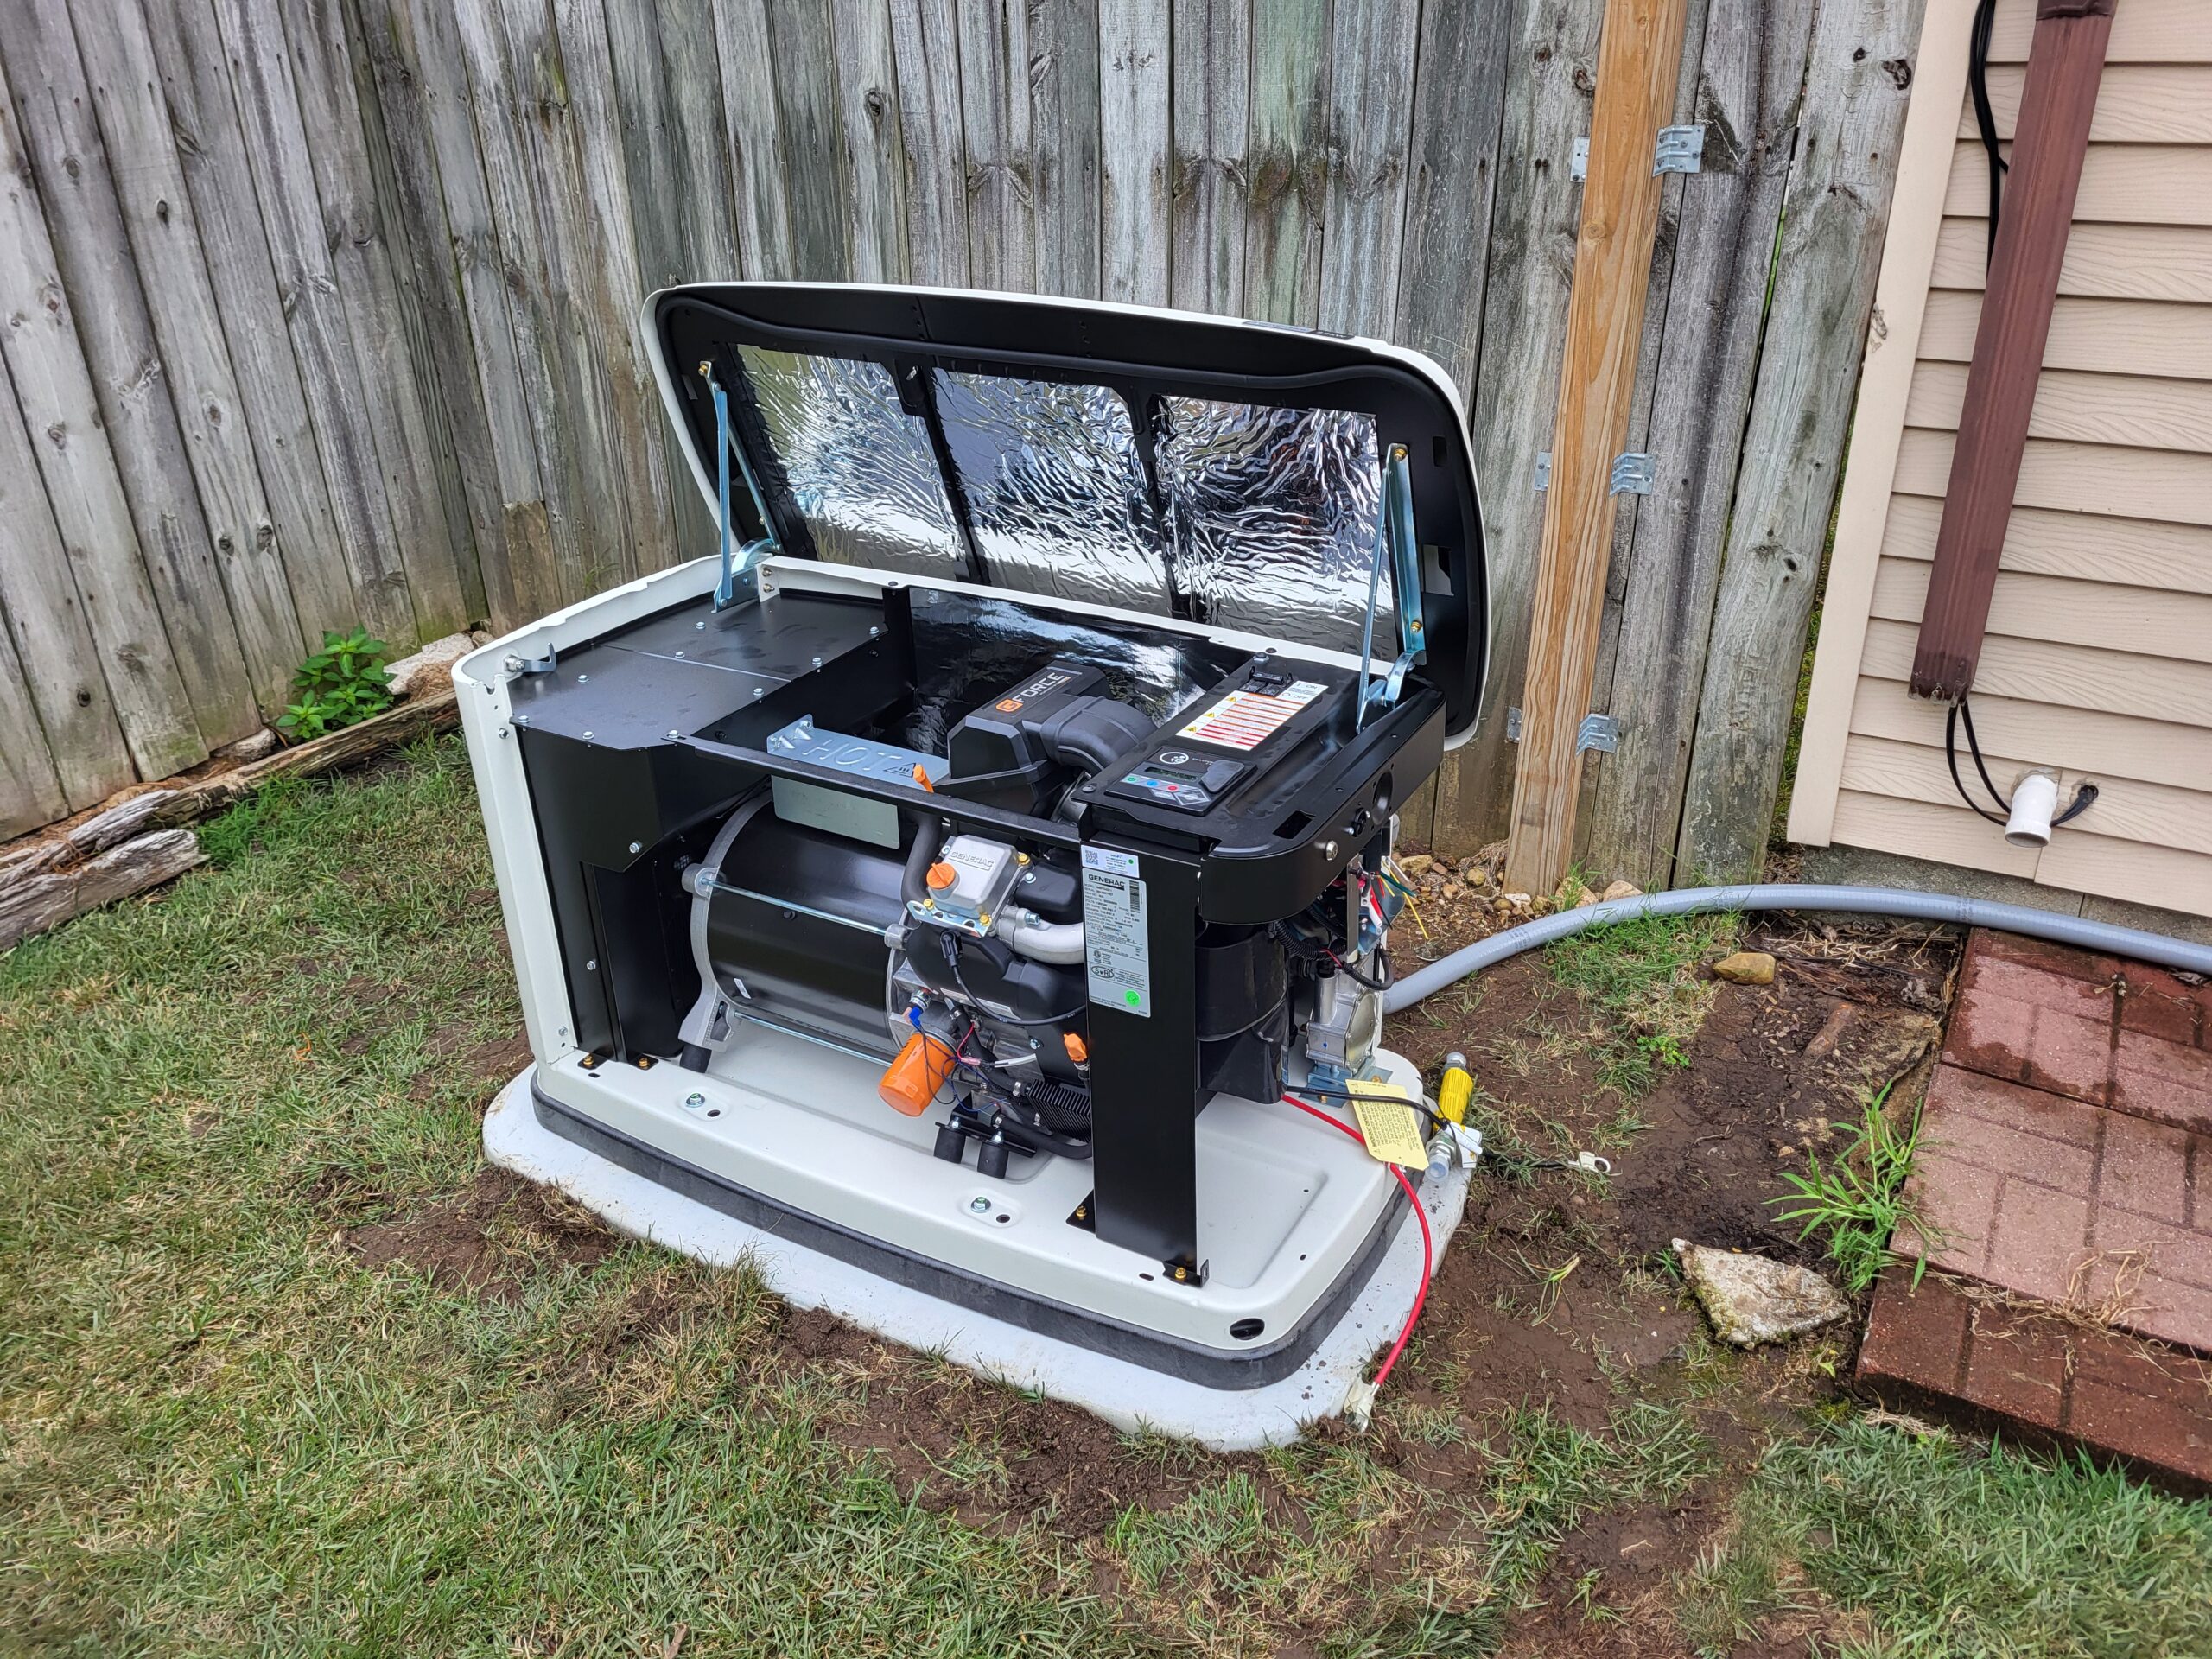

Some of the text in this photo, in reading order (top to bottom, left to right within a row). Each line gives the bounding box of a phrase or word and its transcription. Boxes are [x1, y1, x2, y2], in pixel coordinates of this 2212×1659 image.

[802, 739, 903, 771] HOT
[950, 851, 994, 868] GENERAC
[1089, 874, 1125, 887] GENERAC
